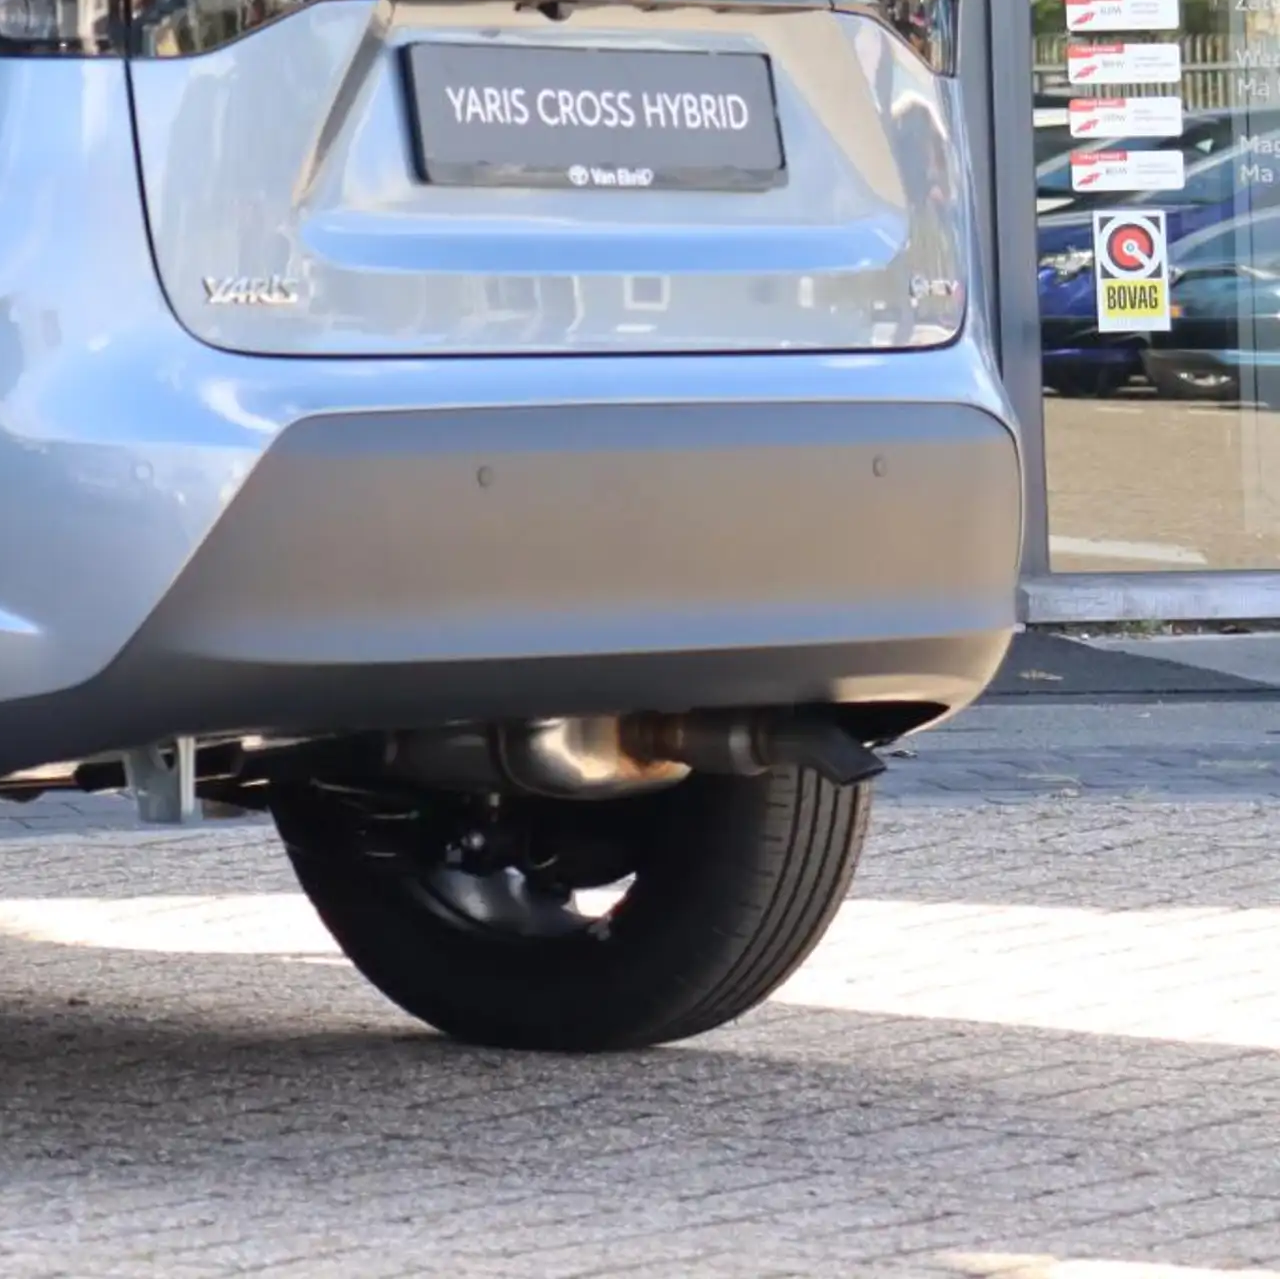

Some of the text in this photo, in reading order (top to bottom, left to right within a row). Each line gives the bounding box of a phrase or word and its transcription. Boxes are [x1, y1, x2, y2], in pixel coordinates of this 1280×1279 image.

[445, 86, 750, 131] YARIS CROSS HYBRID
[590, 168, 617, 186] Van
[200, 274, 300, 305] YARIS
[1106, 285, 1159, 311] BOVAG
